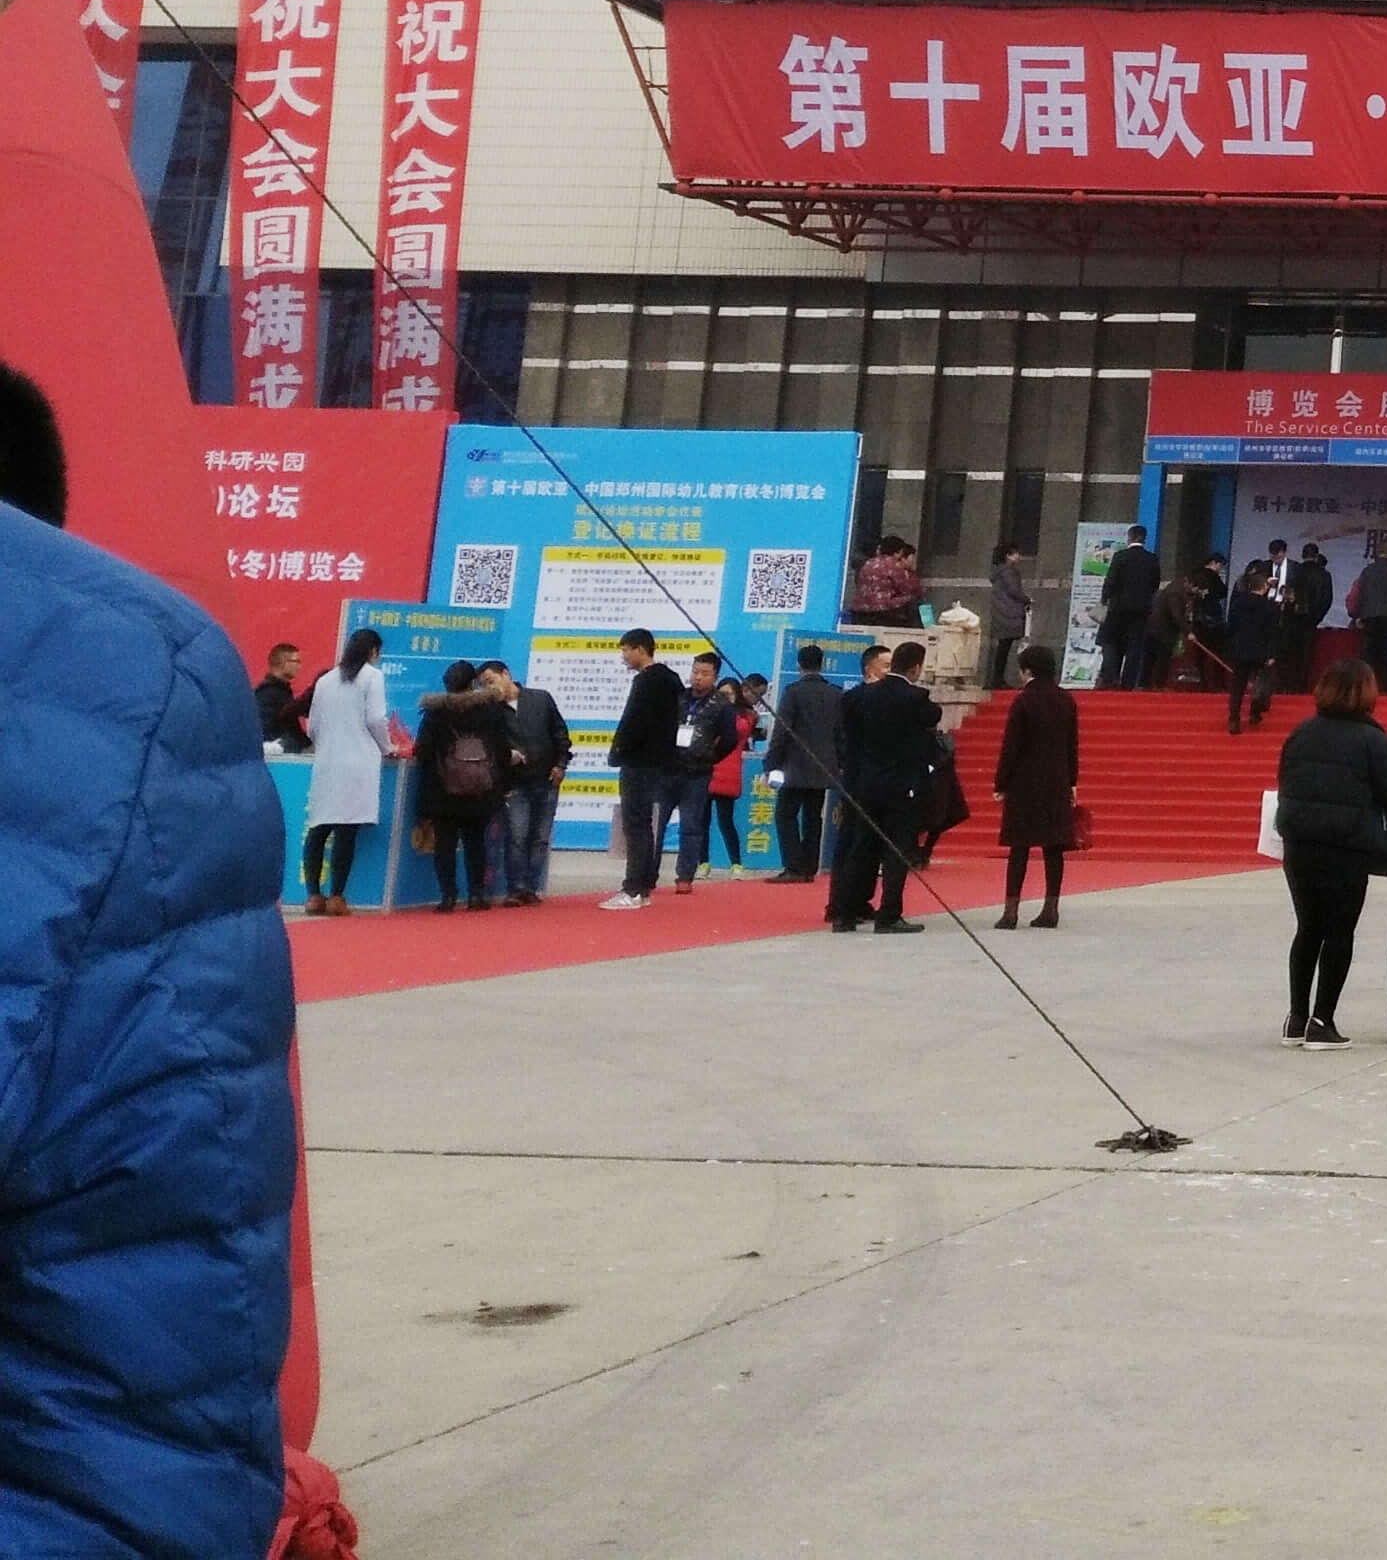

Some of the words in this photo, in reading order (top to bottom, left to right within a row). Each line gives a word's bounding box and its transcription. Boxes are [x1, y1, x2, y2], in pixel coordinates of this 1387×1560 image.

[1245, 420, 1273, 434] The
[1279, 421, 1338, 434] Service
[205, 450, 305, 472] 科研兴园
